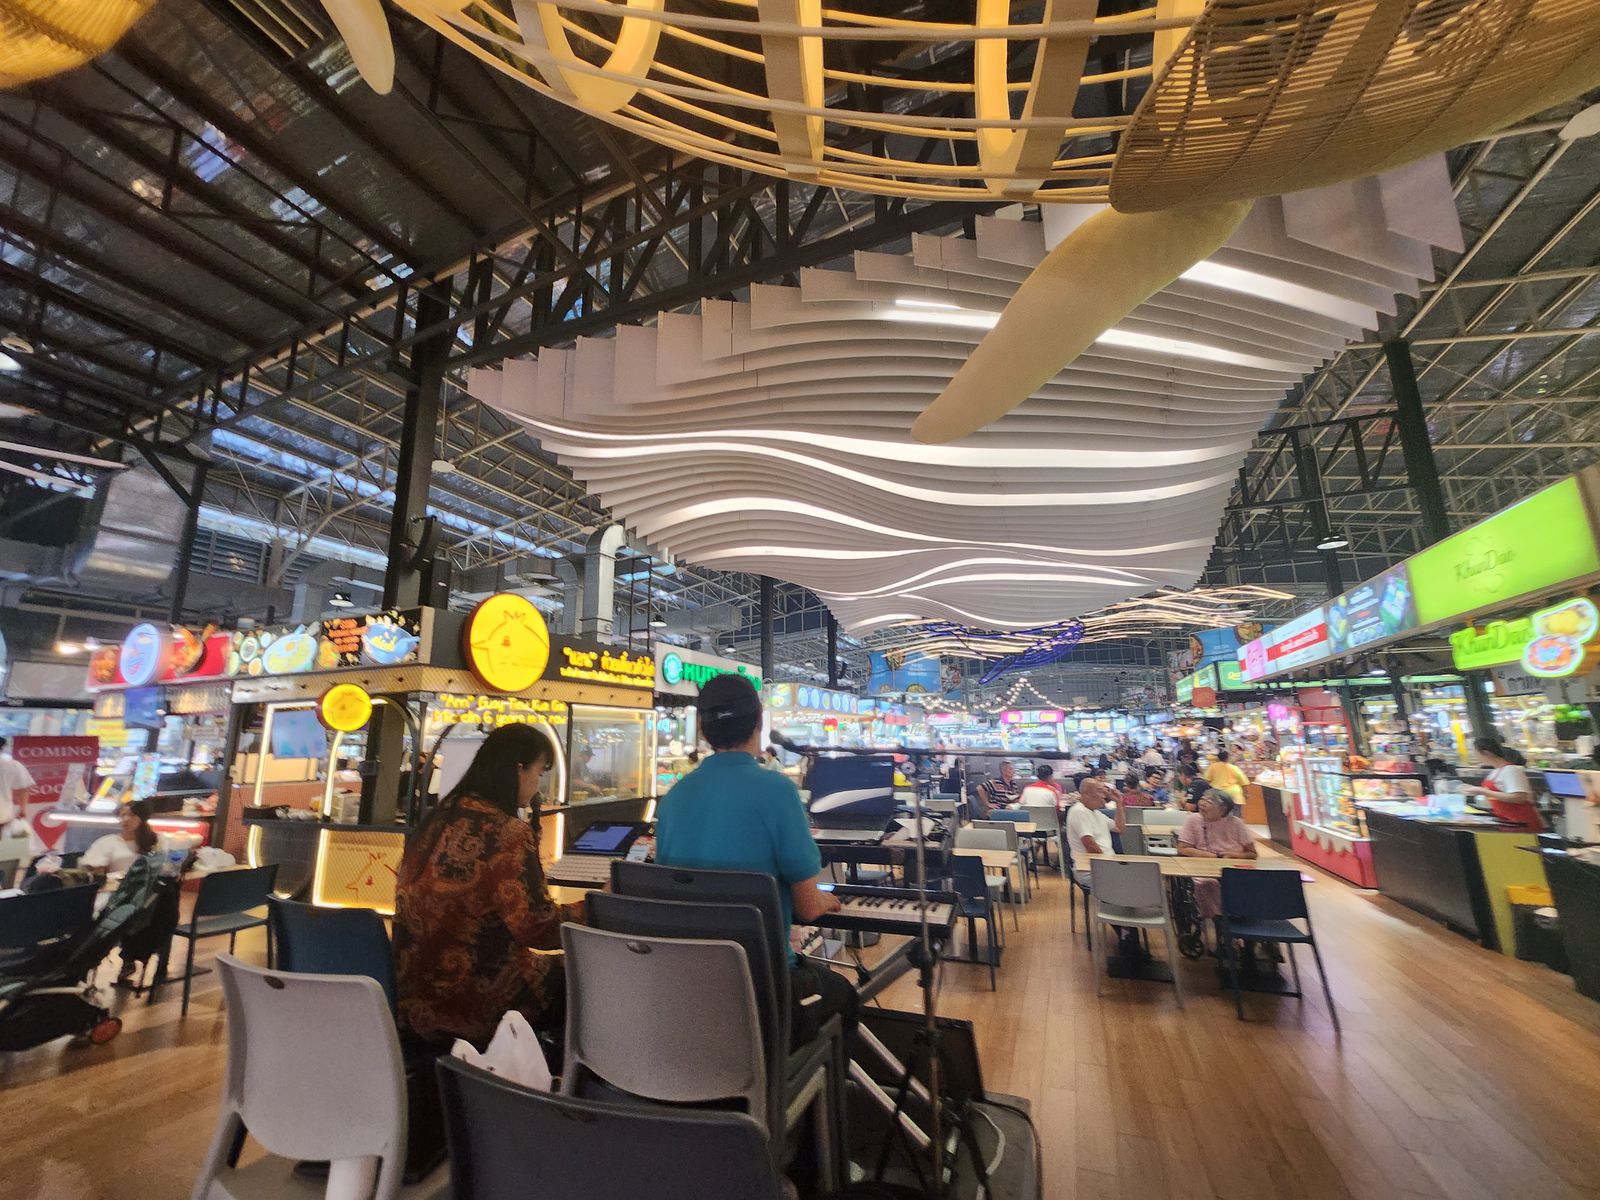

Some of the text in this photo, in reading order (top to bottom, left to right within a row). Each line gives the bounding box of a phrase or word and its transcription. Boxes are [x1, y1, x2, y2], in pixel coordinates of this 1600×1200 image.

[433, 709, 481, 724] Micelin
[483, 710, 494, 725] 6
[18, 746, 92, 758] COMING
[30, 784, 64, 796] SOO
